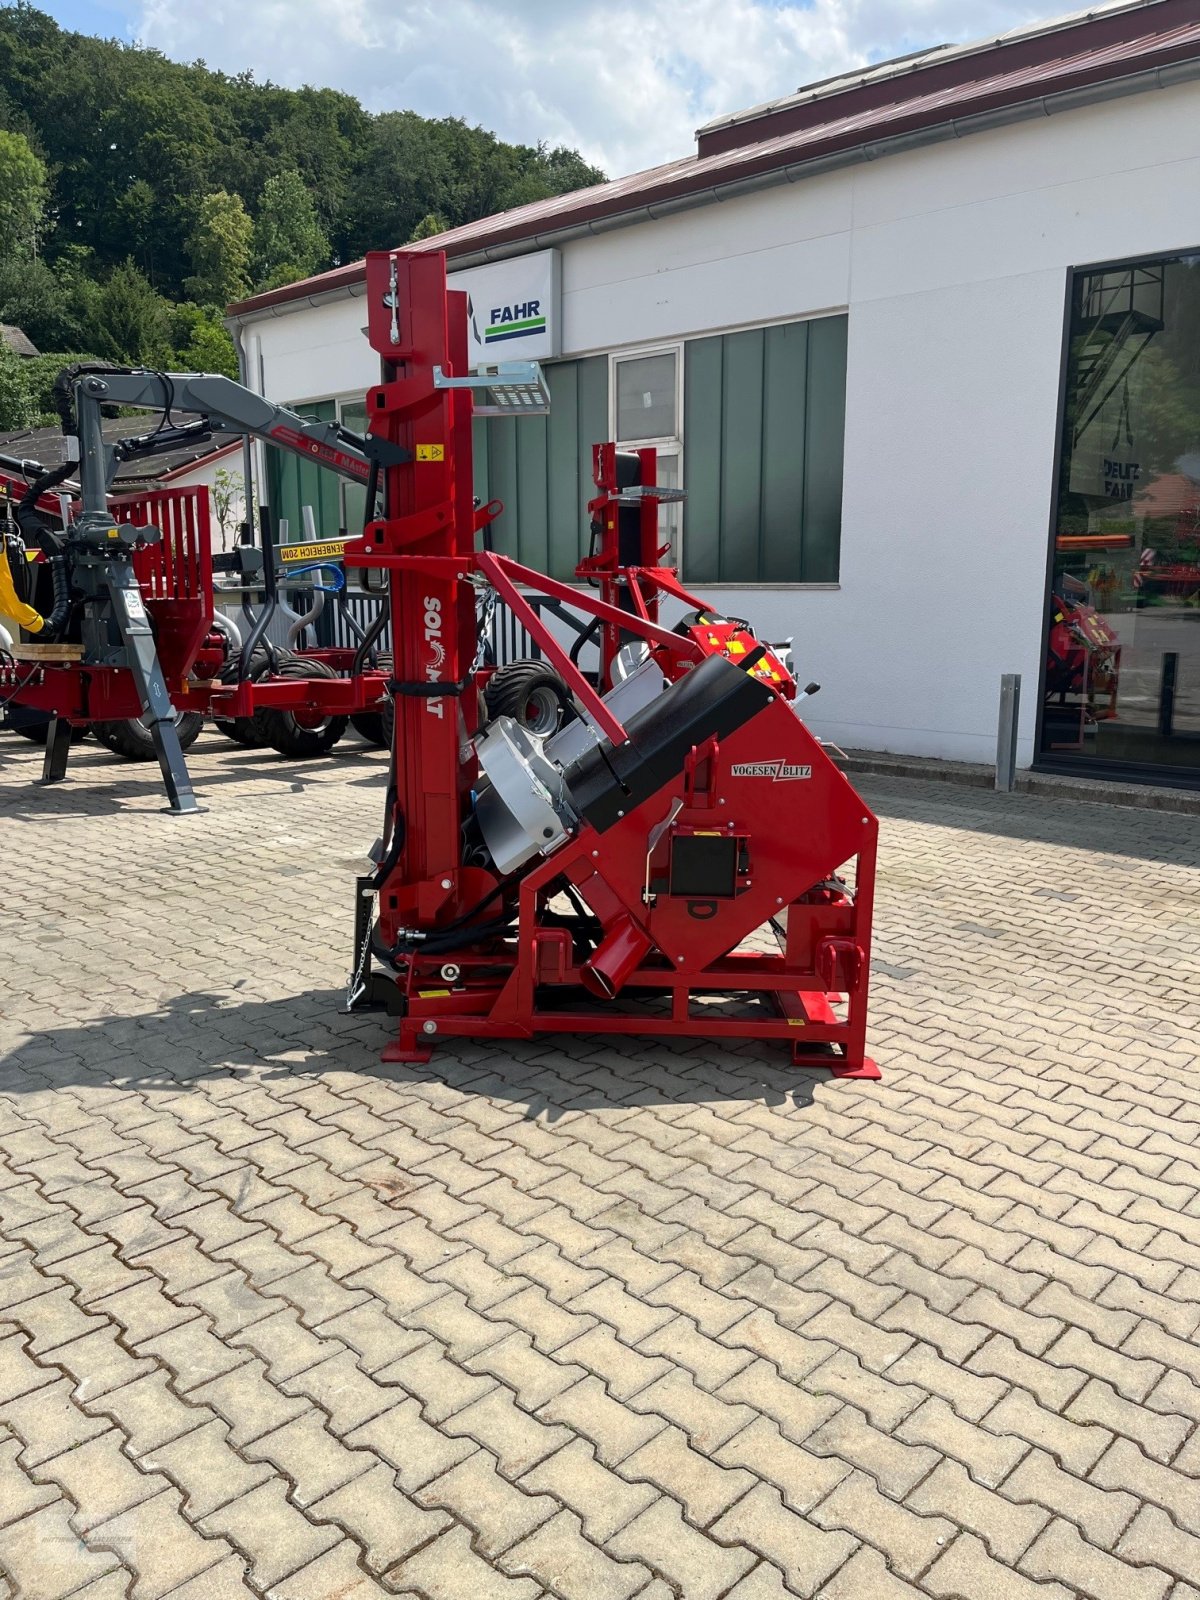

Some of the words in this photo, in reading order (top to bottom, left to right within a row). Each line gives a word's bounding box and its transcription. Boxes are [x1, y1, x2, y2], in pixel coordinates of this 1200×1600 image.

[490, 300, 541, 325] FAHR
[733, 766, 776, 776] VOGESEN
[783, 766, 810, 776] BLITZ
